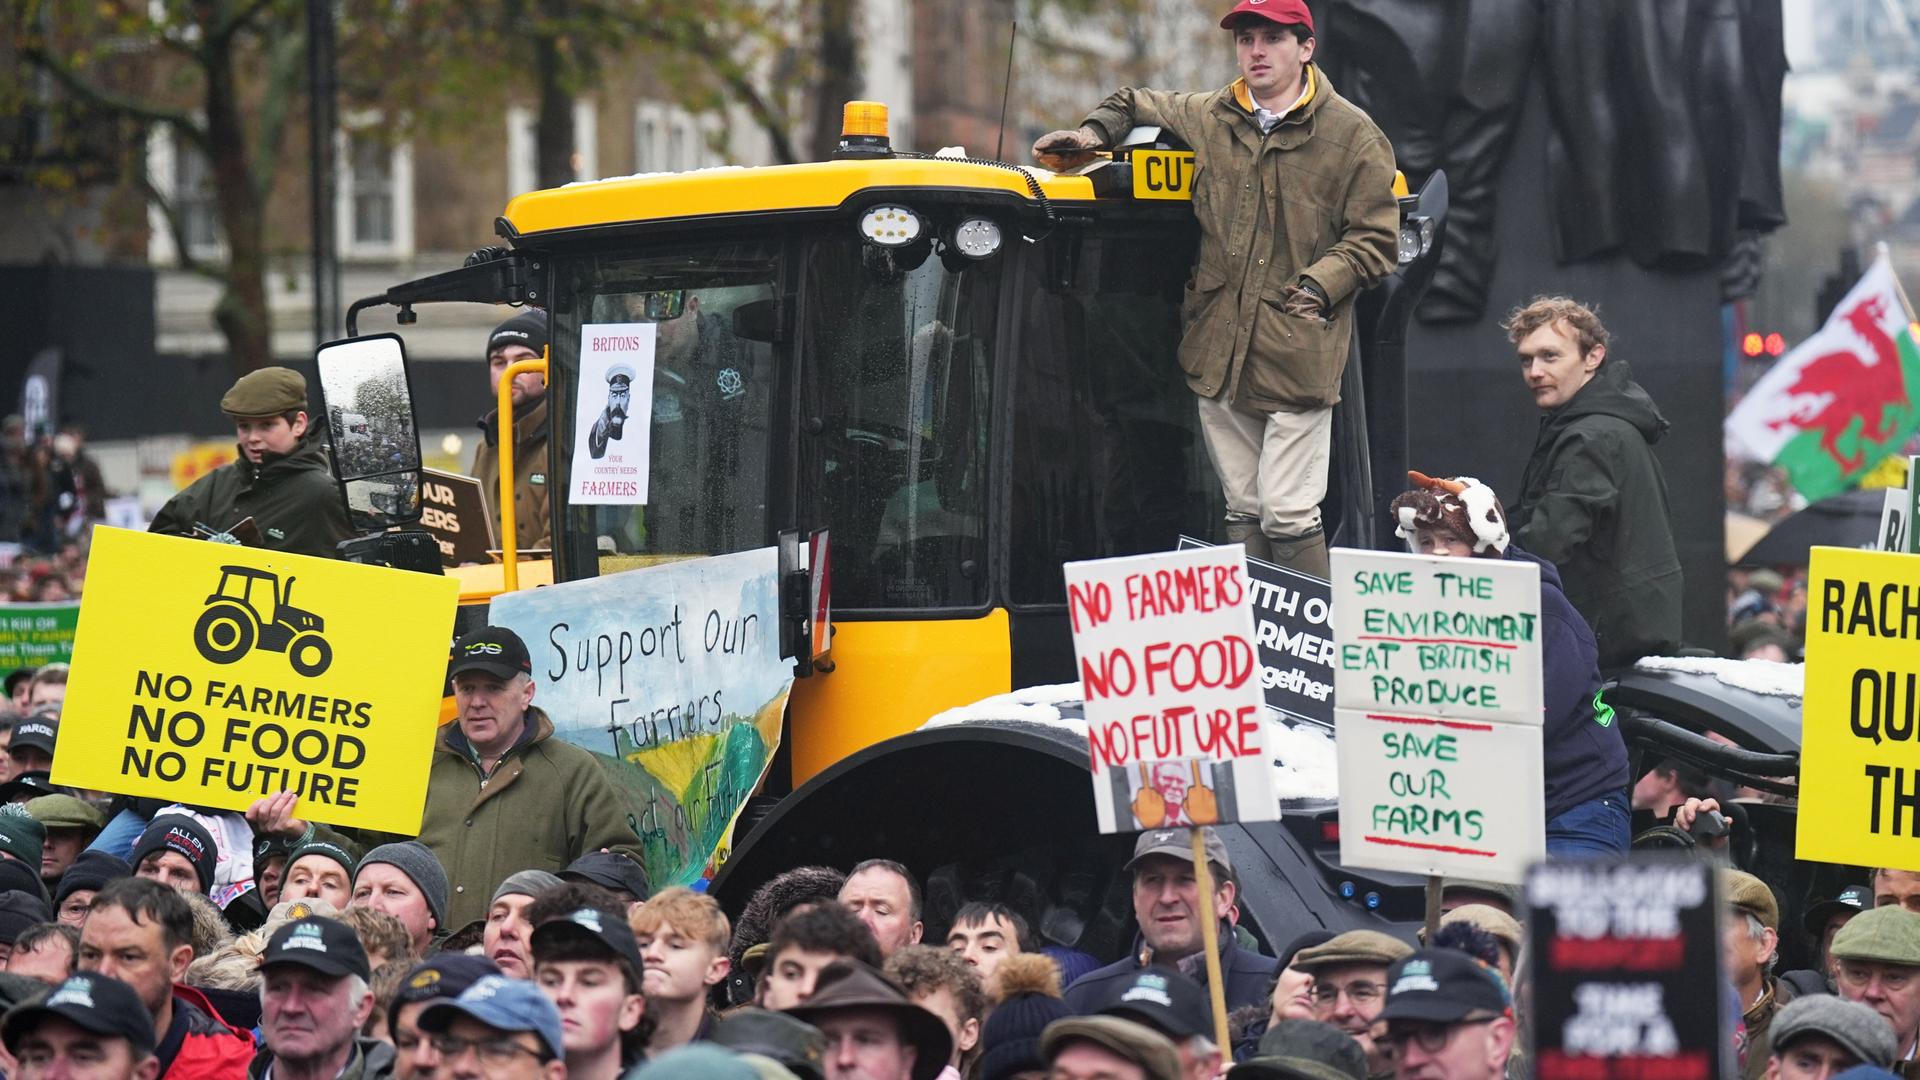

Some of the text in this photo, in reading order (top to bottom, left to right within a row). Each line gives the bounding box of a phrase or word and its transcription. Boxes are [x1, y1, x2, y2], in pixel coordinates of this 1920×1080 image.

[1146, 156, 1195, 192] CU7
[593, 336, 639, 352] BRITONS
[593, 466, 638, 474] COUNTRY NEEDS
[608, 455, 623, 463] YOUR
[582, 481, 637, 496] FARMERS
[1069, 565, 1243, 634] NO FARMERS
[1248, 578, 1301, 617] ITH
[1354, 571, 1493, 599] SAVE THE
[1364, 608, 1536, 642] ENVIRONMENT
[549, 605, 685, 697] Support
[1082, 635, 1253, 701] NO FOOD
[1342, 643, 1511, 674] EAT BRITISH
[135, 670, 372, 729] NO FARMERS
[1259, 663, 1334, 702] gether
[1371, 675, 1500, 708] PRODUCE
[127, 704, 366, 770] NO FOOD
[608, 690, 722, 759] Farmers
[1089, 706, 1261, 775] NO FUTURE
[1383, 732, 1457, 762] SAVE
[121, 746, 360, 807] NO FUTURE
[1390, 768, 1452, 800] OUR
[170, 827, 205, 852] ALLEN
[1373, 803, 1484, 841] FARMS
[163, 833, 204, 861] FARMS
